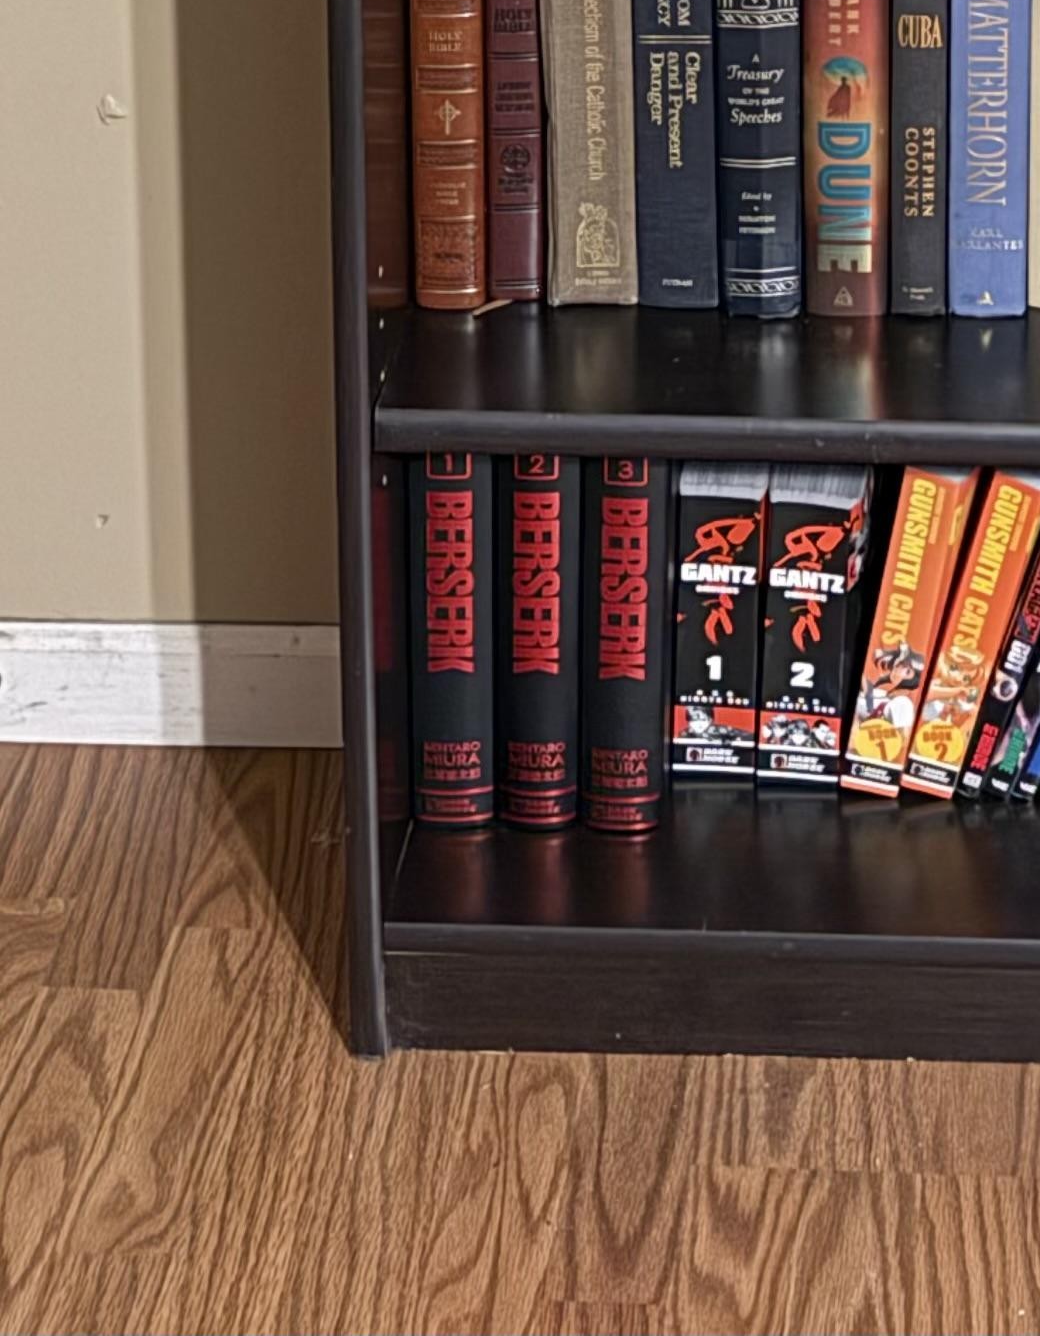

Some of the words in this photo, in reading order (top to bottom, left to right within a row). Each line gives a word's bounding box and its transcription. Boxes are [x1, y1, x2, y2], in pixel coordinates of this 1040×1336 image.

[898, 14, 943, 49] CUBA
[647, 52, 665, 126] Danger
[683, 52, 700, 104] Clear
[817, 122, 872, 274] DUNE
[904, 128, 919, 218] COONTS
[922, 128, 935, 218] STEPHEN
[681, 563, 756, 584] GANTZ
[893, 478, 937, 590] GUNSMITH
[969, 484, 1022, 595] GUNSMITH
[427, 490, 474, 673] BERSERK
[513, 490, 561, 674] BERSERK
[600, 497, 649, 680] BERSERK
[769, 568, 844, 593] GANTZ
[881, 593, 914, 646] CATS
[706, 656, 721, 680] 1
[790, 662, 814, 687] 2
